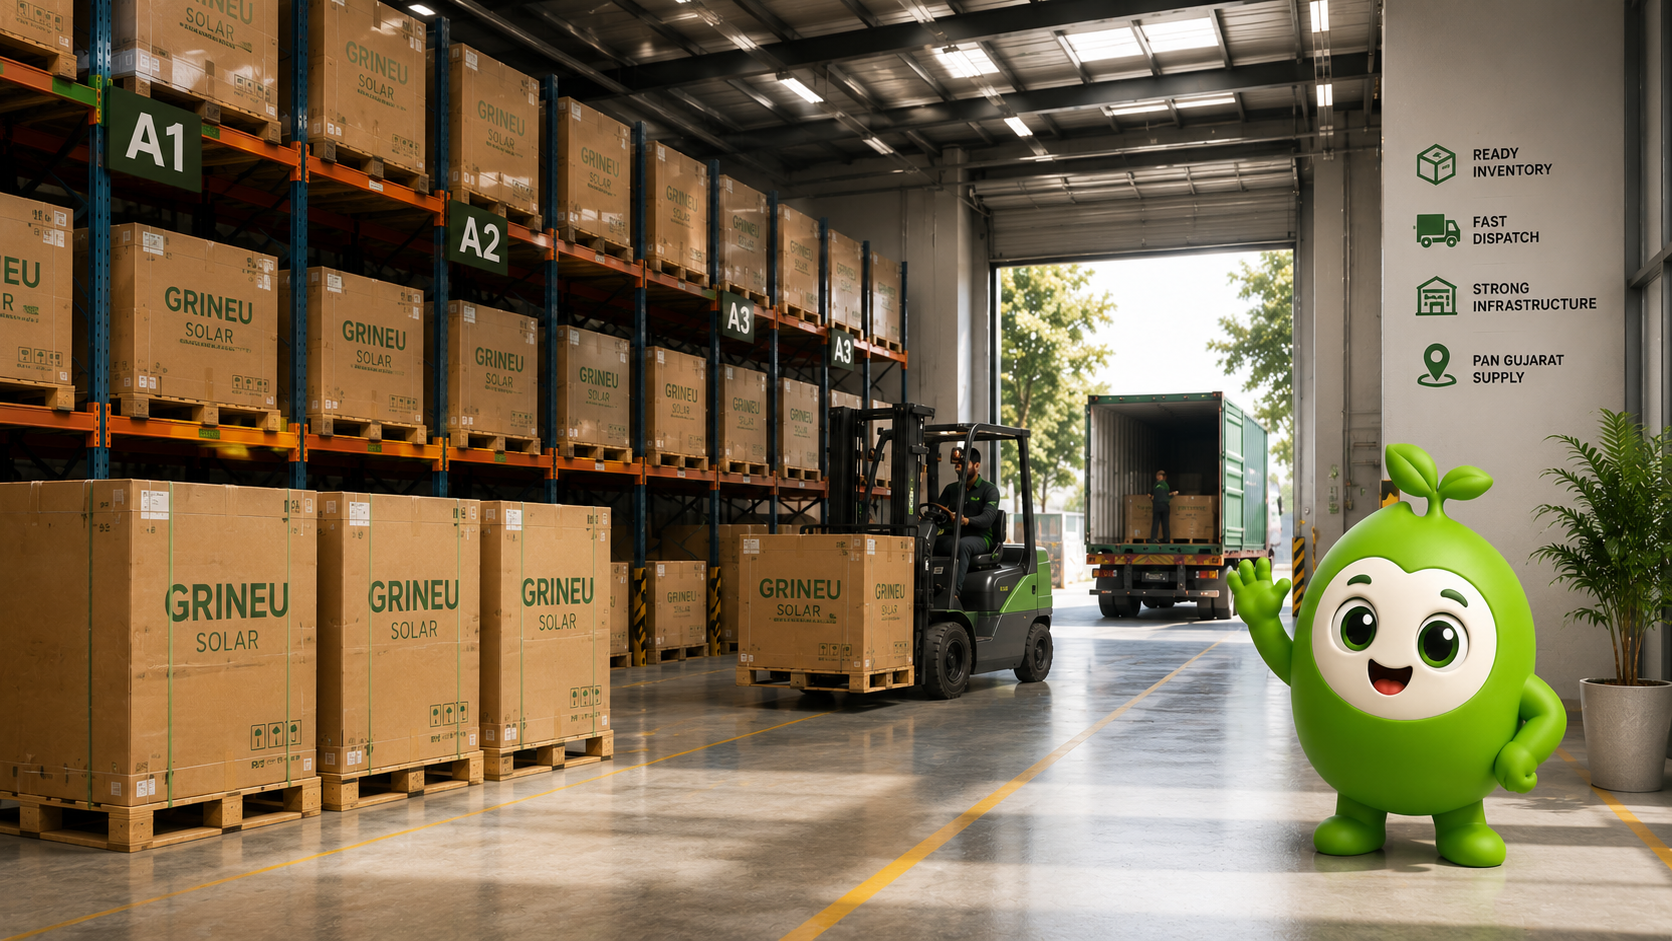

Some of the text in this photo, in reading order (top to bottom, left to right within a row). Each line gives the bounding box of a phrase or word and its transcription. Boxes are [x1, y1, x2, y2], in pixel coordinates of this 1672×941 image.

[186, 7, 234, 41] SOLAR
[345, 41, 408, 85] GRINEU
[358, 73, 394, 100] SOLAR
[477, 100, 525, 137] GRINEU
[125, 111, 183, 173] A1
[488, 128, 515, 150] SOLAR
[581, 146, 620, 178] GRINEU
[1473, 147, 1519, 160] READY
[589, 171, 612, 190] SOLAR
[1473, 163, 1553, 178] INVENTORY
[666, 185, 698, 213] GRINEU
[1473, 215, 1507, 228] FAST
[459, 216, 500, 263] A2
[1473, 231, 1540, 245] DISPATCH
[1473, 282, 1530, 295] STRONG
[165, 286, 253, 325] GRINEU
[1473, 297, 1597, 312] INFRASTRUCTURE
[727, 302, 750, 334] A3
[185, 322, 233, 344] SOLAR
[342, 320, 406, 351] GRINEU
[356, 349, 392, 368] SOLAR
[475, 346, 524, 373] GRINEU
[834, 336, 851, 364] A3
[1473, 353, 1565, 367] PAN GUJARAT
[485, 372, 513, 388] SOLAR
[579, 366, 619, 389] GRINEU
[1473, 371, 1525, 384] SUPPLY
[588, 388, 611, 403] SOLAR
[665, 383, 698, 403] GRINEU
[368, 579, 459, 613] GRINEU
[521, 577, 594, 607] GRINEU
[667, 591, 697, 603] GRINEU
[759, 578, 841, 600] GRINEU
[875, 583, 905, 600] GRINEU
[165, 583, 288, 622] GRINEU
[776, 603, 821, 617] SOLAR
[391, 620, 438, 640] SOLAR
[538, 612, 577, 631] SOLAR
[196, 630, 258, 653] SOLAR
